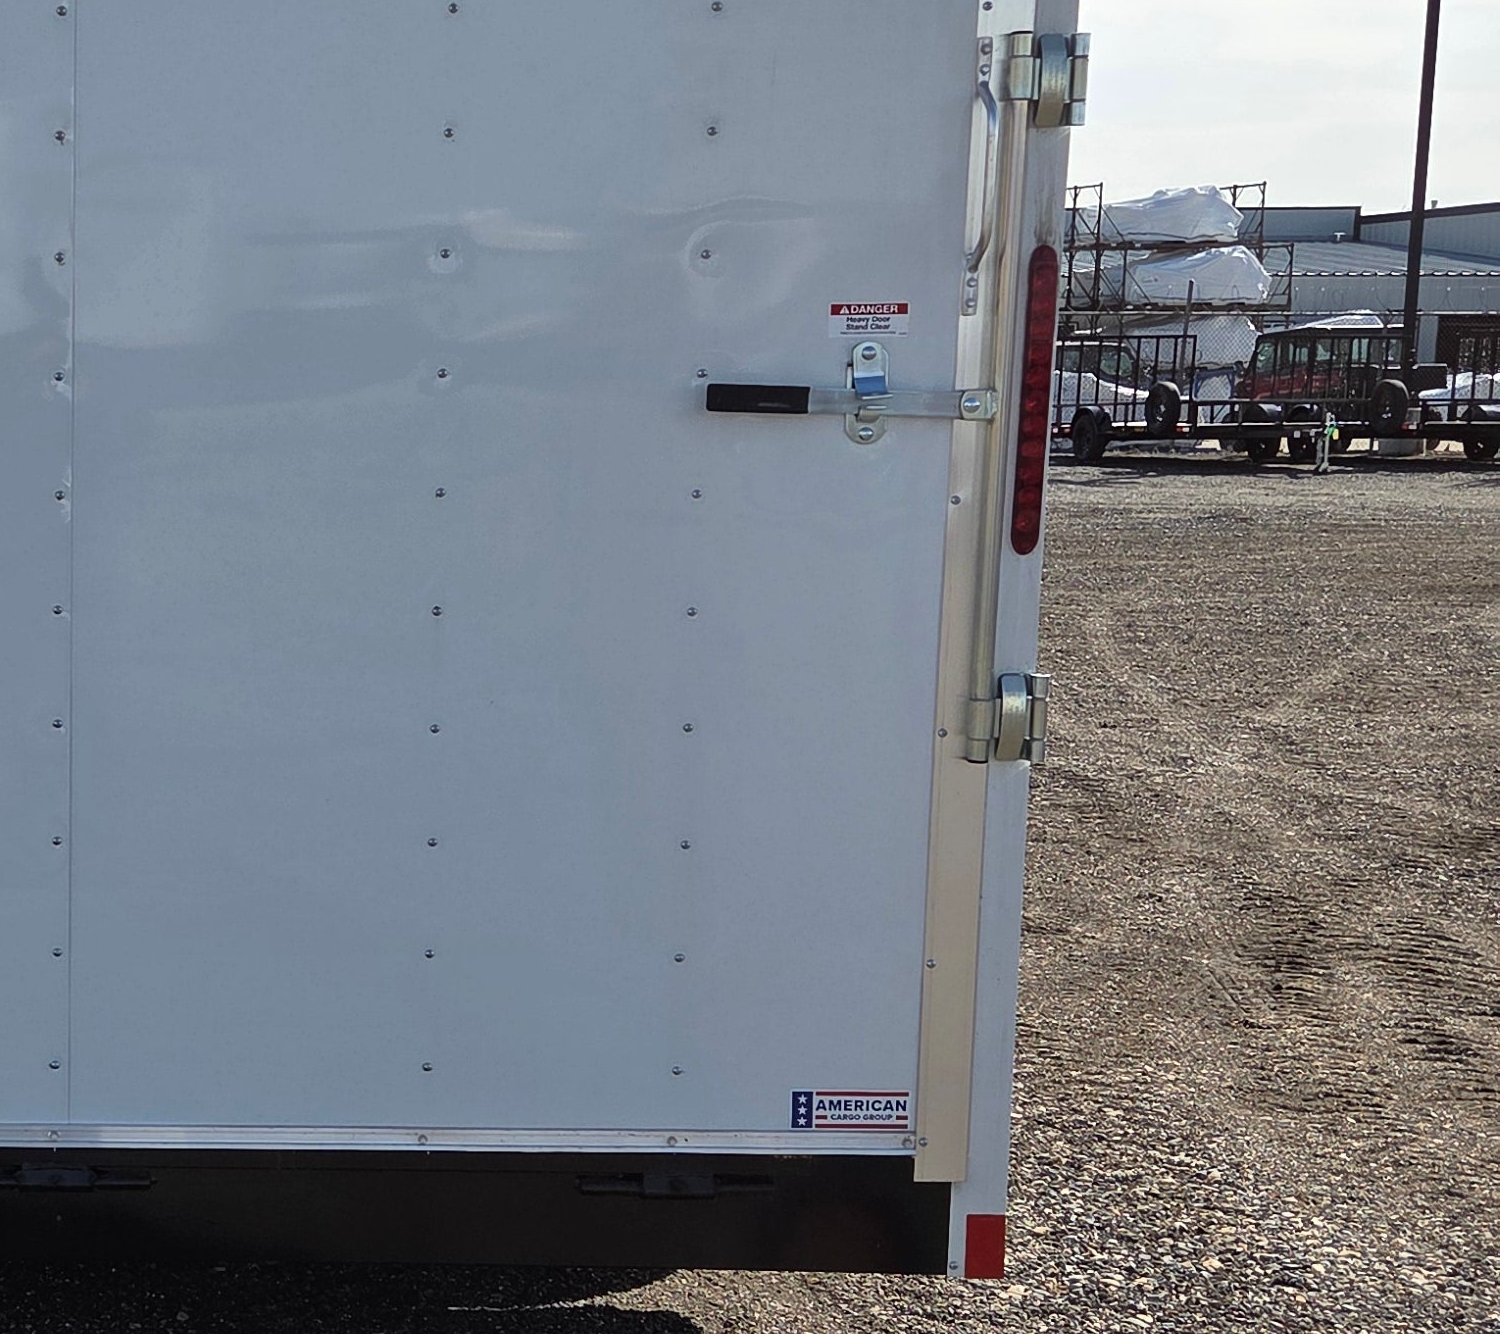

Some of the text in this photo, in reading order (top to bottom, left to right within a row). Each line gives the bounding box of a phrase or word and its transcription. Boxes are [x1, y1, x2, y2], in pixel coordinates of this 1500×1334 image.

[850, 304, 899, 314] DANGER
[846, 315, 891, 324] Heavy Door
[815, 1099, 908, 1112] AMERICAN
[830, 1113, 894, 1121] CARGO GROUP
